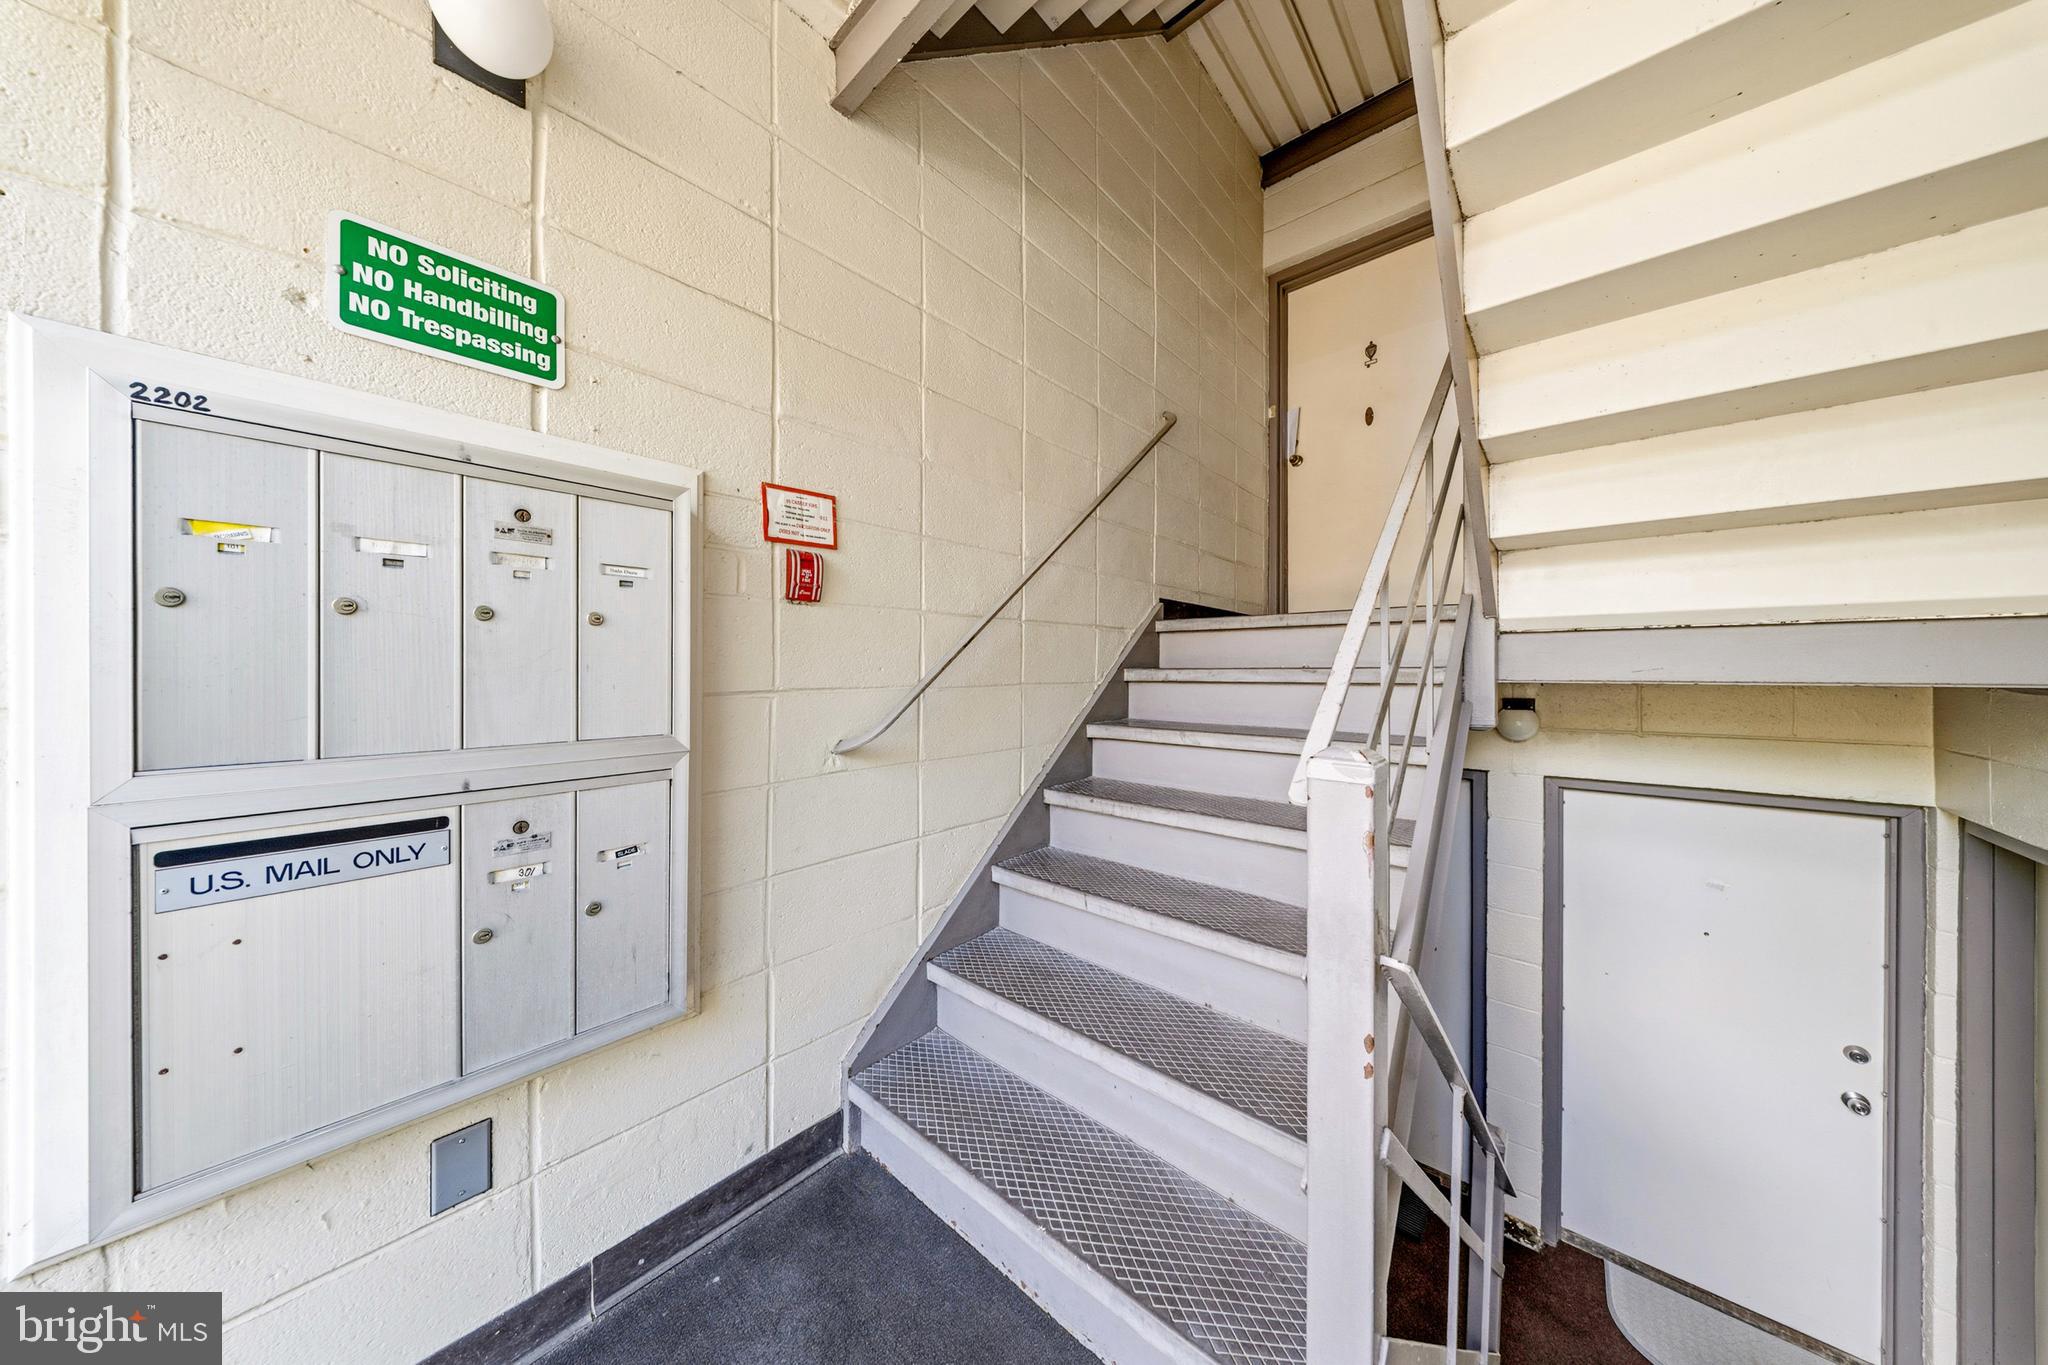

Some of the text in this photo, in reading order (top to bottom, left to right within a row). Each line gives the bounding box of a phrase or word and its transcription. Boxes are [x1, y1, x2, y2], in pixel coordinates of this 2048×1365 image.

[352, 261, 548, 345] NO Handbilling
[367, 235, 537, 315] NO Soliciting
[348, 291, 551, 371] NO Trespassing
[129, 381, 211, 412] 2202
[190, 842, 427, 895] U.S. MAIL ONLY
